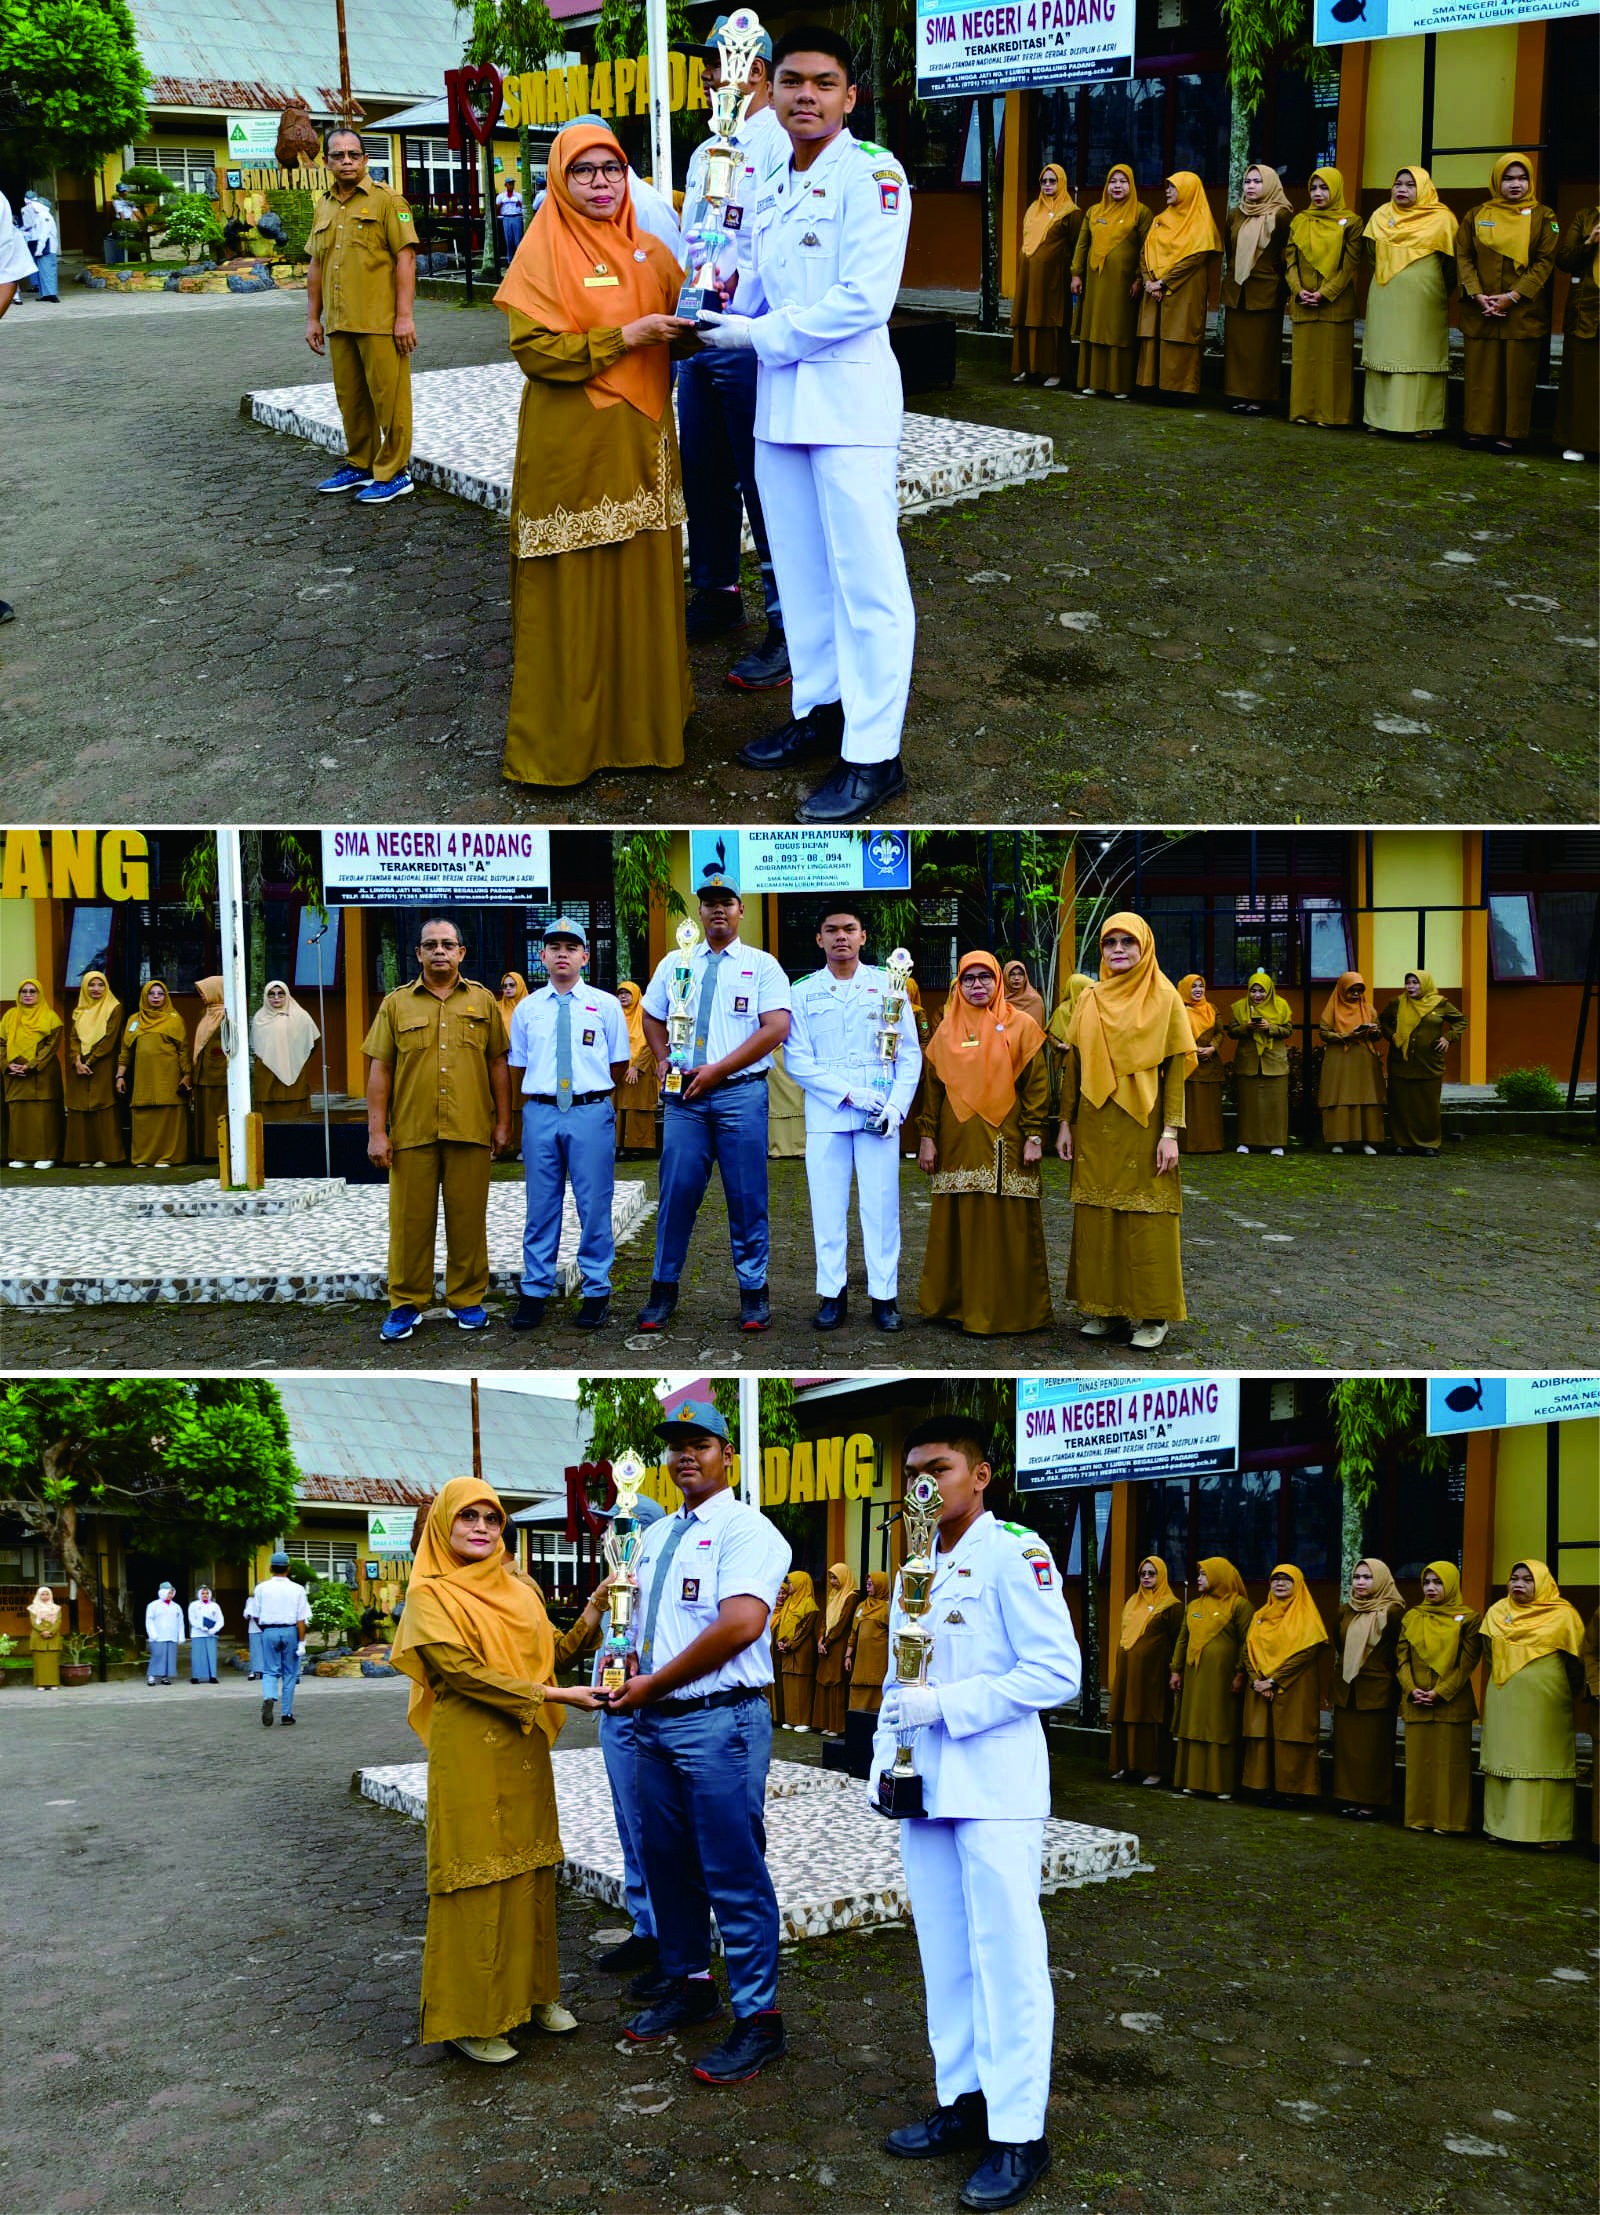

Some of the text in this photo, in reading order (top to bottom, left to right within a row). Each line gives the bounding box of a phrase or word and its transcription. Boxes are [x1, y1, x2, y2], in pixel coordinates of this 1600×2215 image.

[1413, 0, 1580, 27] KECAMATAN LUBUK BEGALUNG
[1432, 4, 1455, 15] SMA
[1459, 0, 1498, 11] NEGERI
[926, 0, 1115, 45] SMA NEGERI 4 PADANG
[965, 36, 1046, 57] TERAKREDITASI
[1068, 61, 1096, 71] PADANG
[749, 831, 798, 841] GERAKAN
[335, 832, 532, 858] SMA NEGERI 4 PADANG
[774, 841, 829, 850] GUGUS DEPAN
[0, 830, 150, 901] ANG
[762, 854, 773, 863] 08
[781, 854, 798, 863] 093
[807, 853, 818, 862] 08
[825, 853, 842, 861] 094
[380, 860, 491, 872] TERAKREDITASI "A"
[393, 874, 420, 882] NASIONAL
[1078, 1378, 1142, 1393] DINAS PENDIDIKAN
[1554, 1394, 1579, 1403] SMA
[1026, 1384, 1219, 1438] SMA NEGERI 4 PADANG
[1064, 1428, 1147, 1450] TERAKREDITASI
[1170, 1453, 1200, 1462] PADANG
